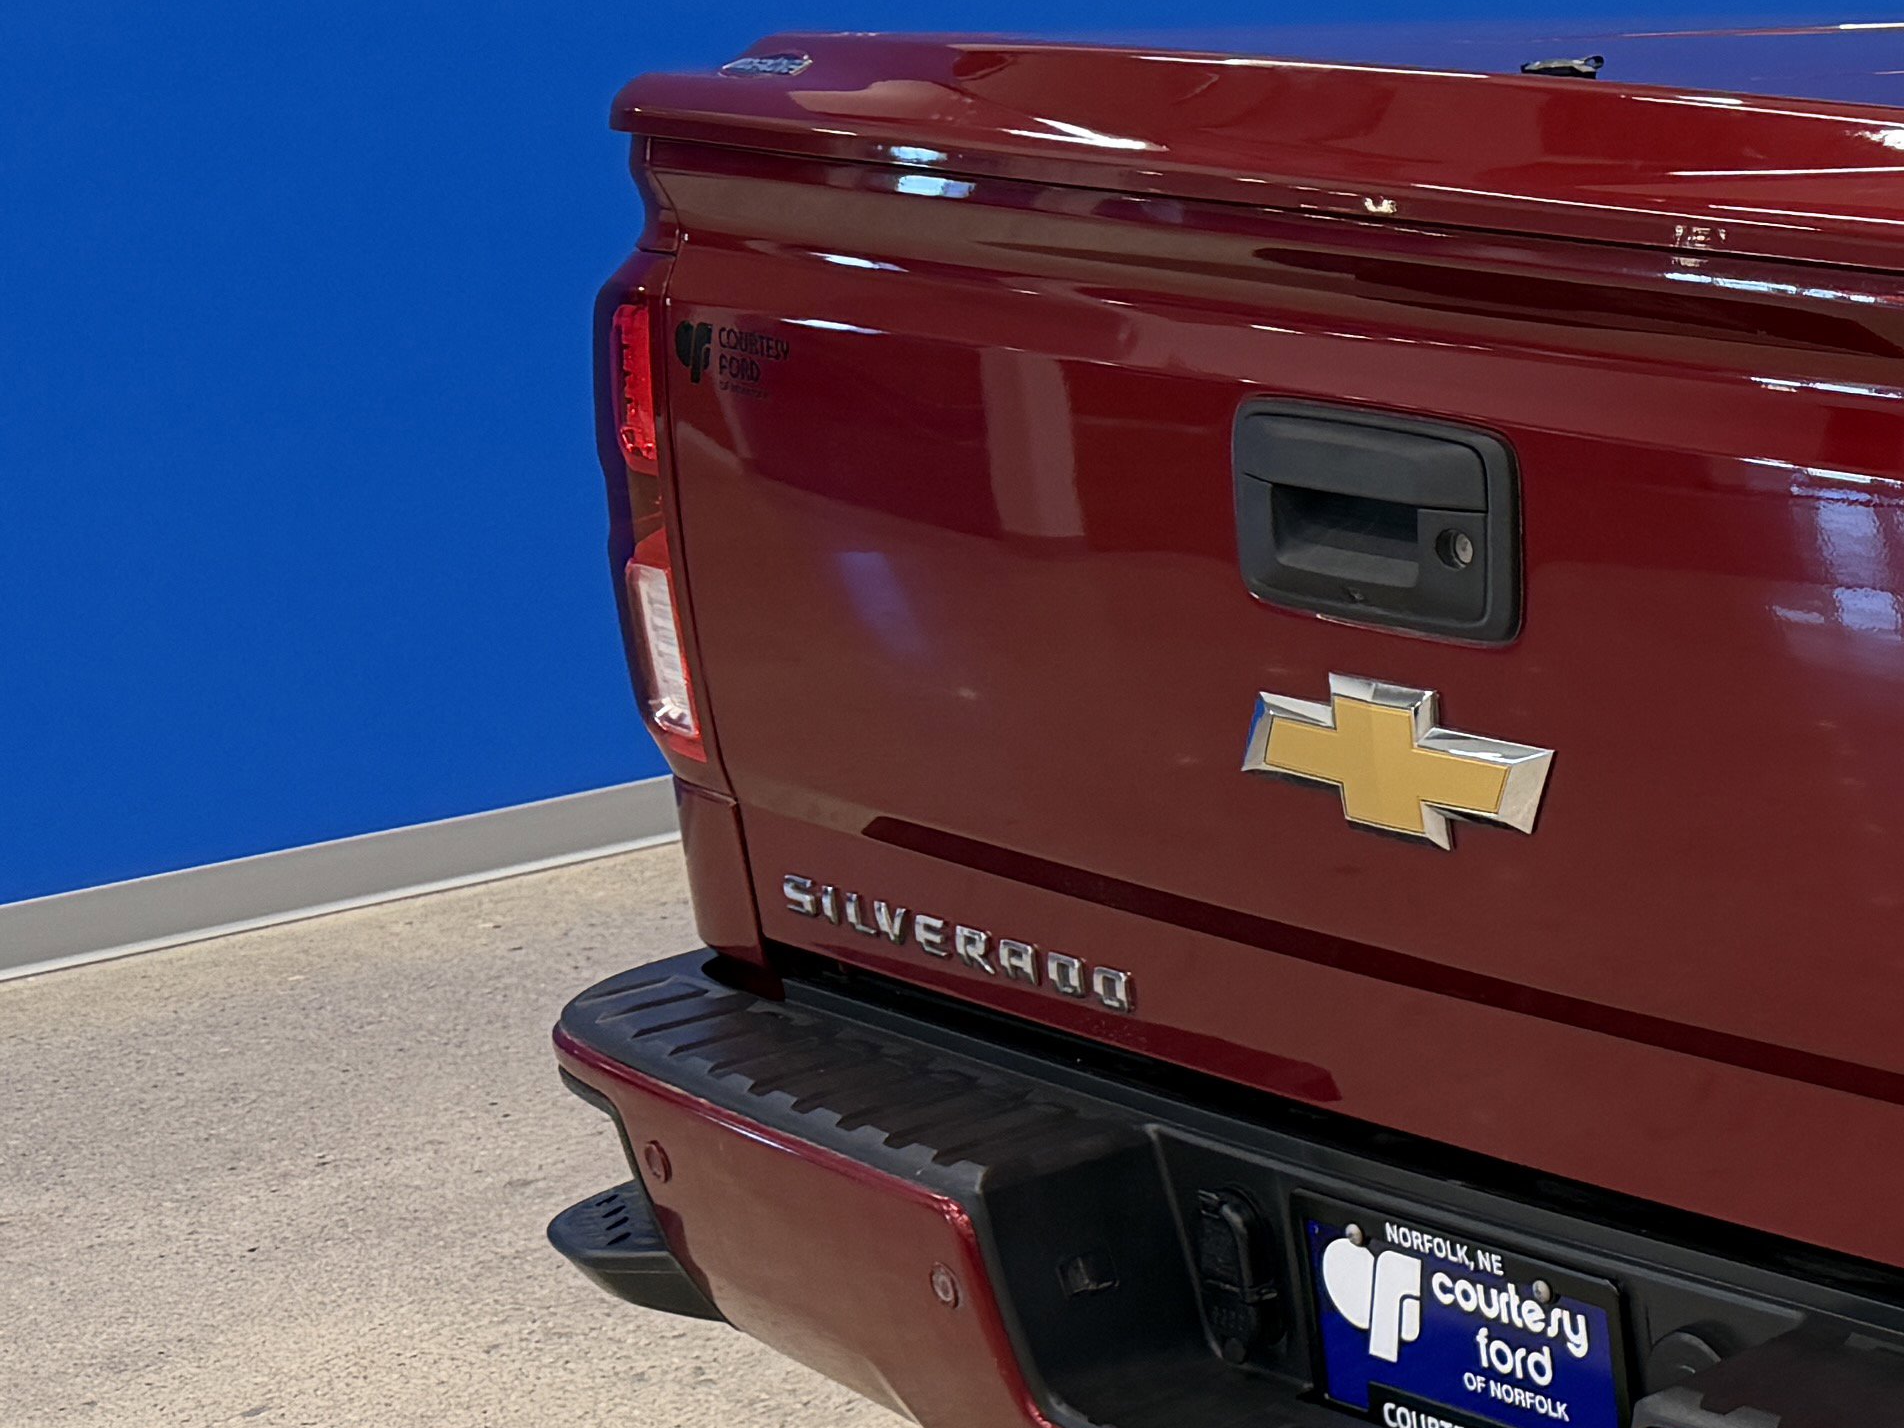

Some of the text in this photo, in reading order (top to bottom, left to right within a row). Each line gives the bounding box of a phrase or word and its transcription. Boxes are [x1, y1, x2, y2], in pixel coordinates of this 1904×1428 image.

[718, 326, 790, 361] COURTESY
[718, 353, 761, 383] FORD
[782, 872, 1138, 1014] SILVERADO
[1385, 1222, 1505, 1276] NORFOLK, NE
[1431, 1271, 1590, 1359] courtesy
[1475, 1326, 1554, 1387] ford
[1462, 1372, 1571, 1422] OF NORFOLK
